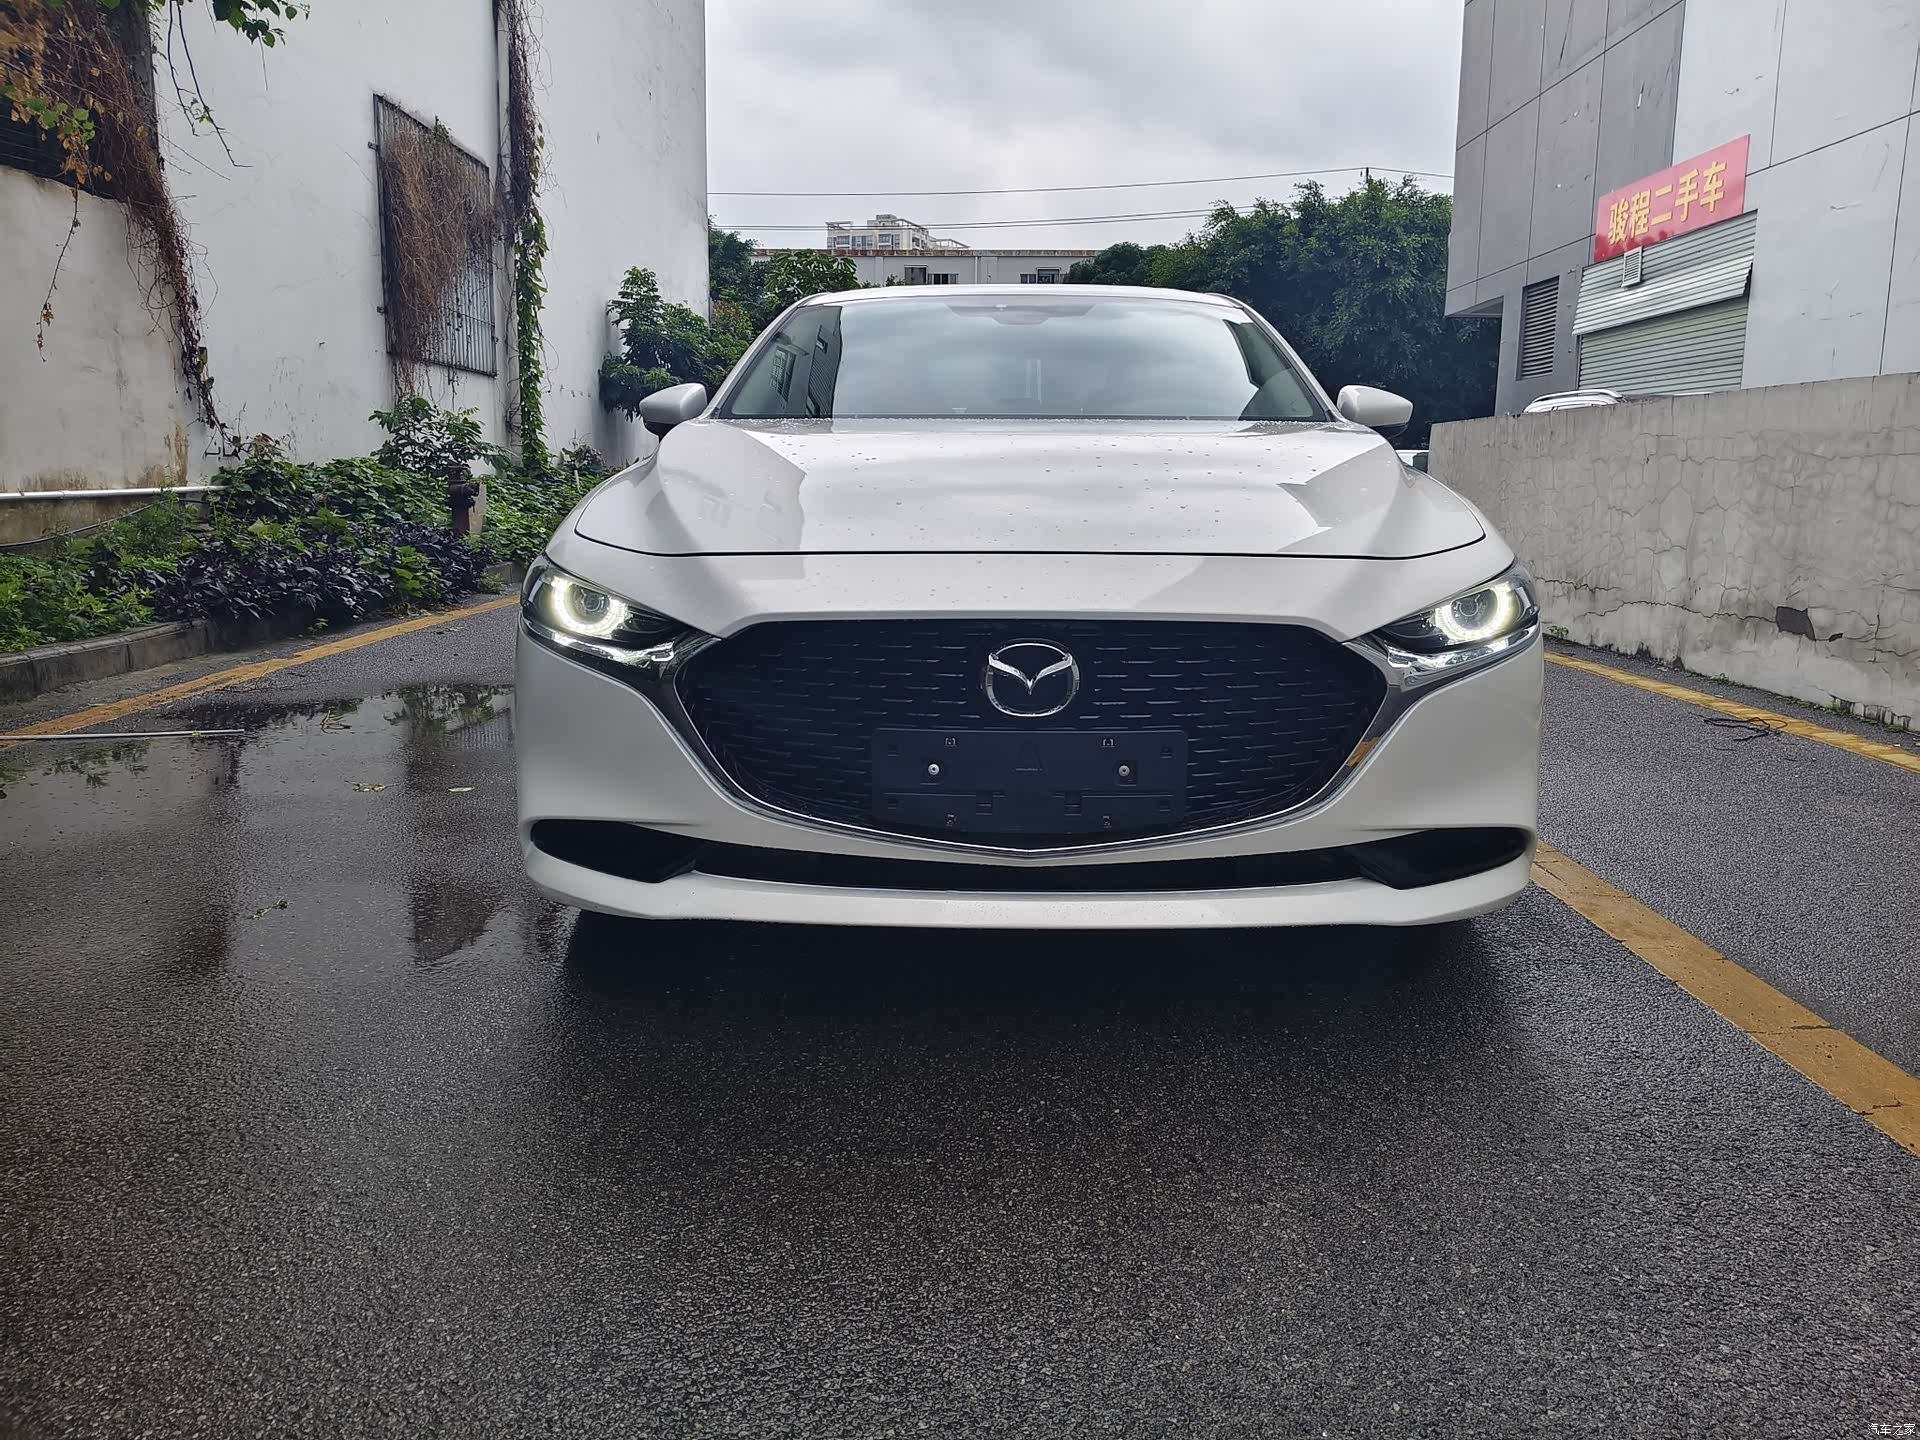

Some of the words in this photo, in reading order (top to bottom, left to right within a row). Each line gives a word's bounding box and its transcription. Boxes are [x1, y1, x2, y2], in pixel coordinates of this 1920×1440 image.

[1608, 161, 1727, 245] 骏程二手车
